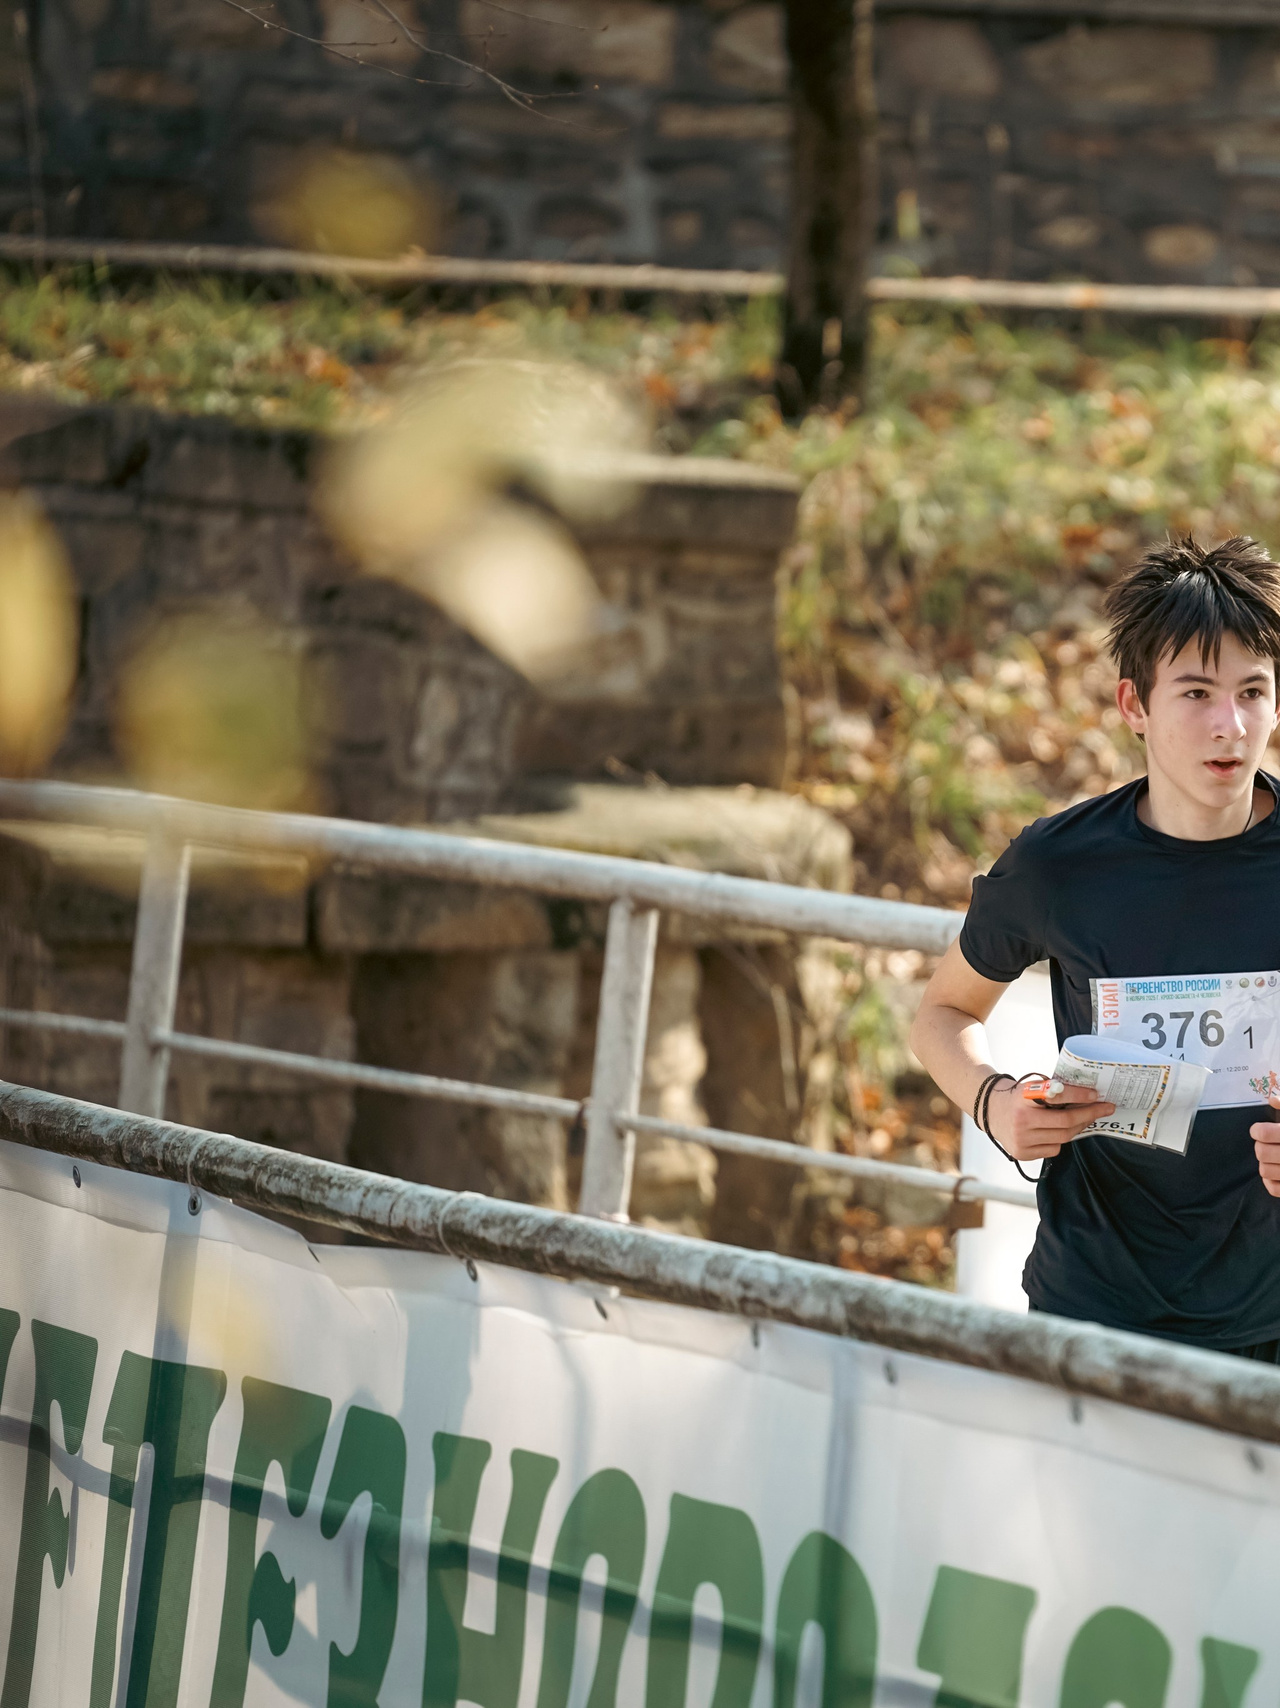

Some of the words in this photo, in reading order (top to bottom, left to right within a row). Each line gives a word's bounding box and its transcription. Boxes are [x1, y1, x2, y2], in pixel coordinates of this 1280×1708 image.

[1102, 983, 1119, 1018] ЭТАП
[1125, 980, 1183, 995] ПЕРВЕНСТВО
[1185, 978, 1220, 992] РОССИИ
[1141, 1009, 1225, 1051] 376
[1243, 1026, 1253, 1049] 1
